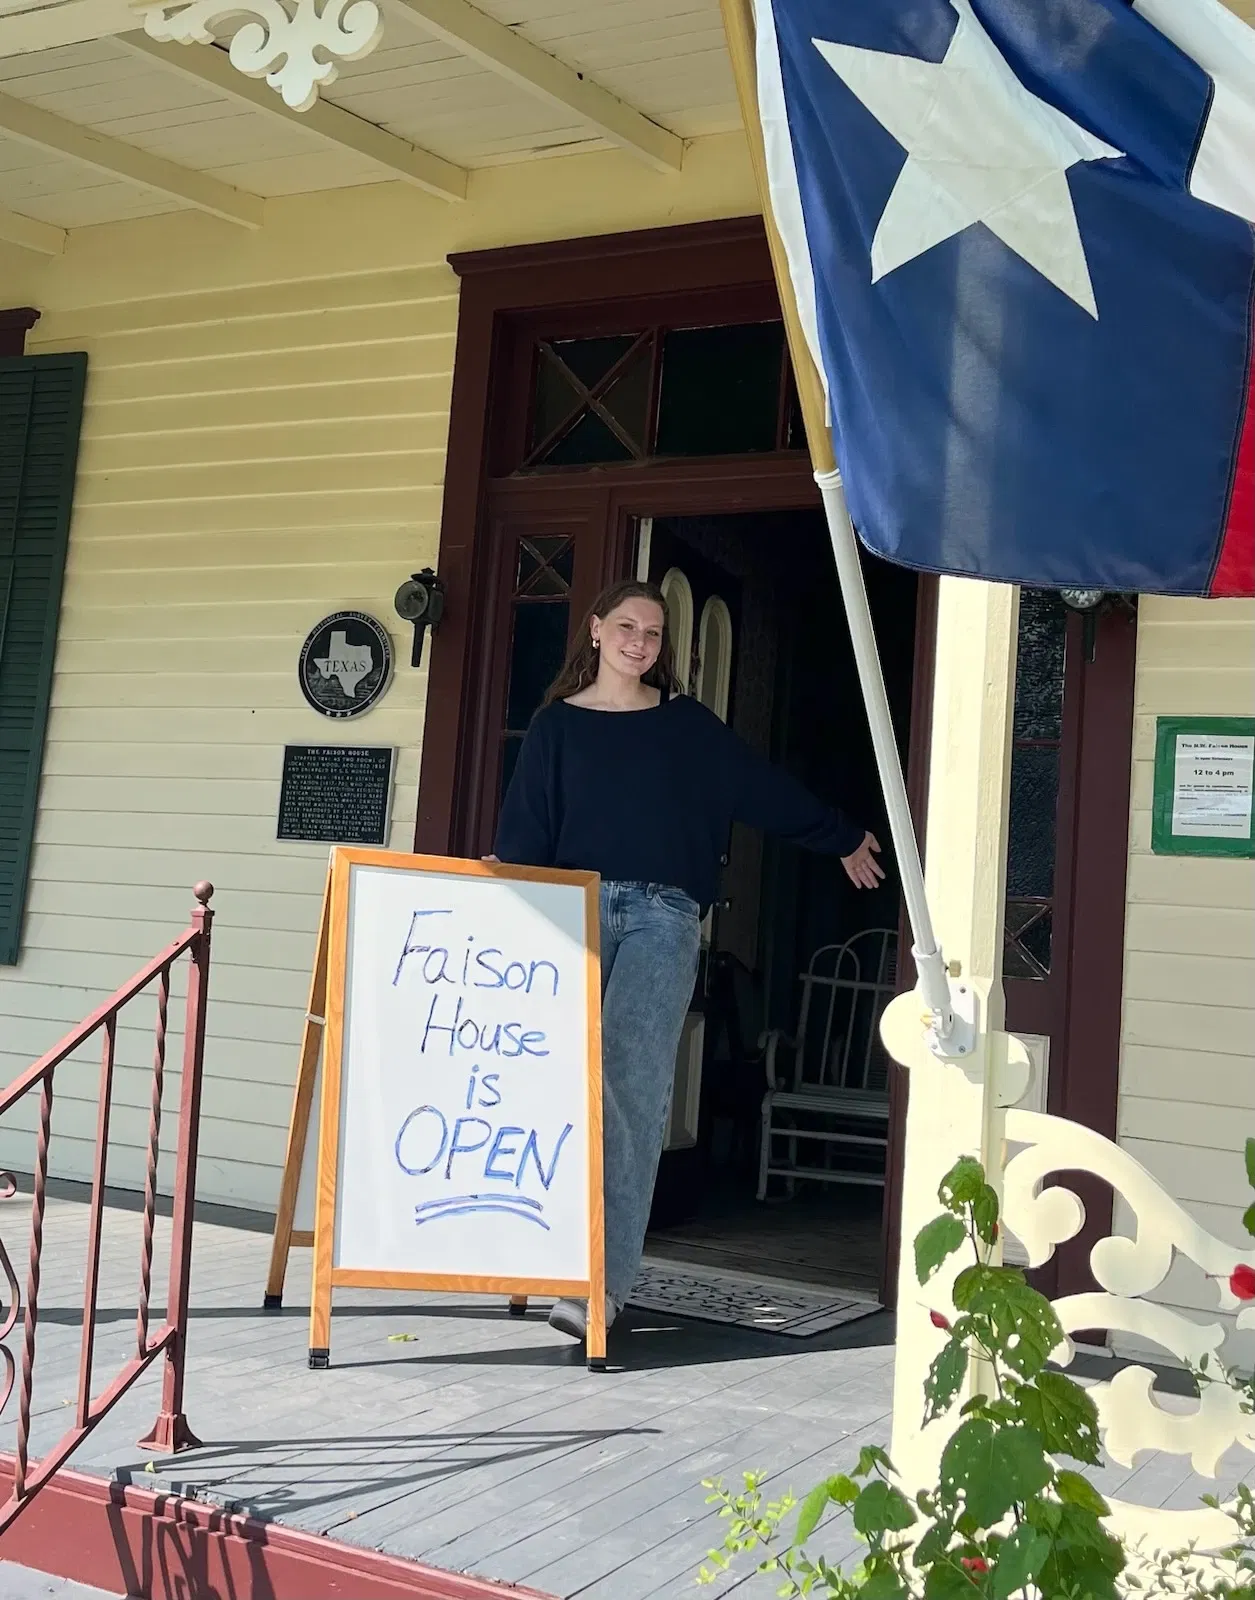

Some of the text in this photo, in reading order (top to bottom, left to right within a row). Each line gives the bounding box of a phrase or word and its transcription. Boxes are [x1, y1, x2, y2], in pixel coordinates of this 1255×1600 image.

[324, 660, 368, 673] TEXAS
[392, 910, 559, 996] Faison
[420, 993, 551, 1057] House
[466, 1064, 502, 1109] is
[394, 1104, 573, 1191] OPEN
